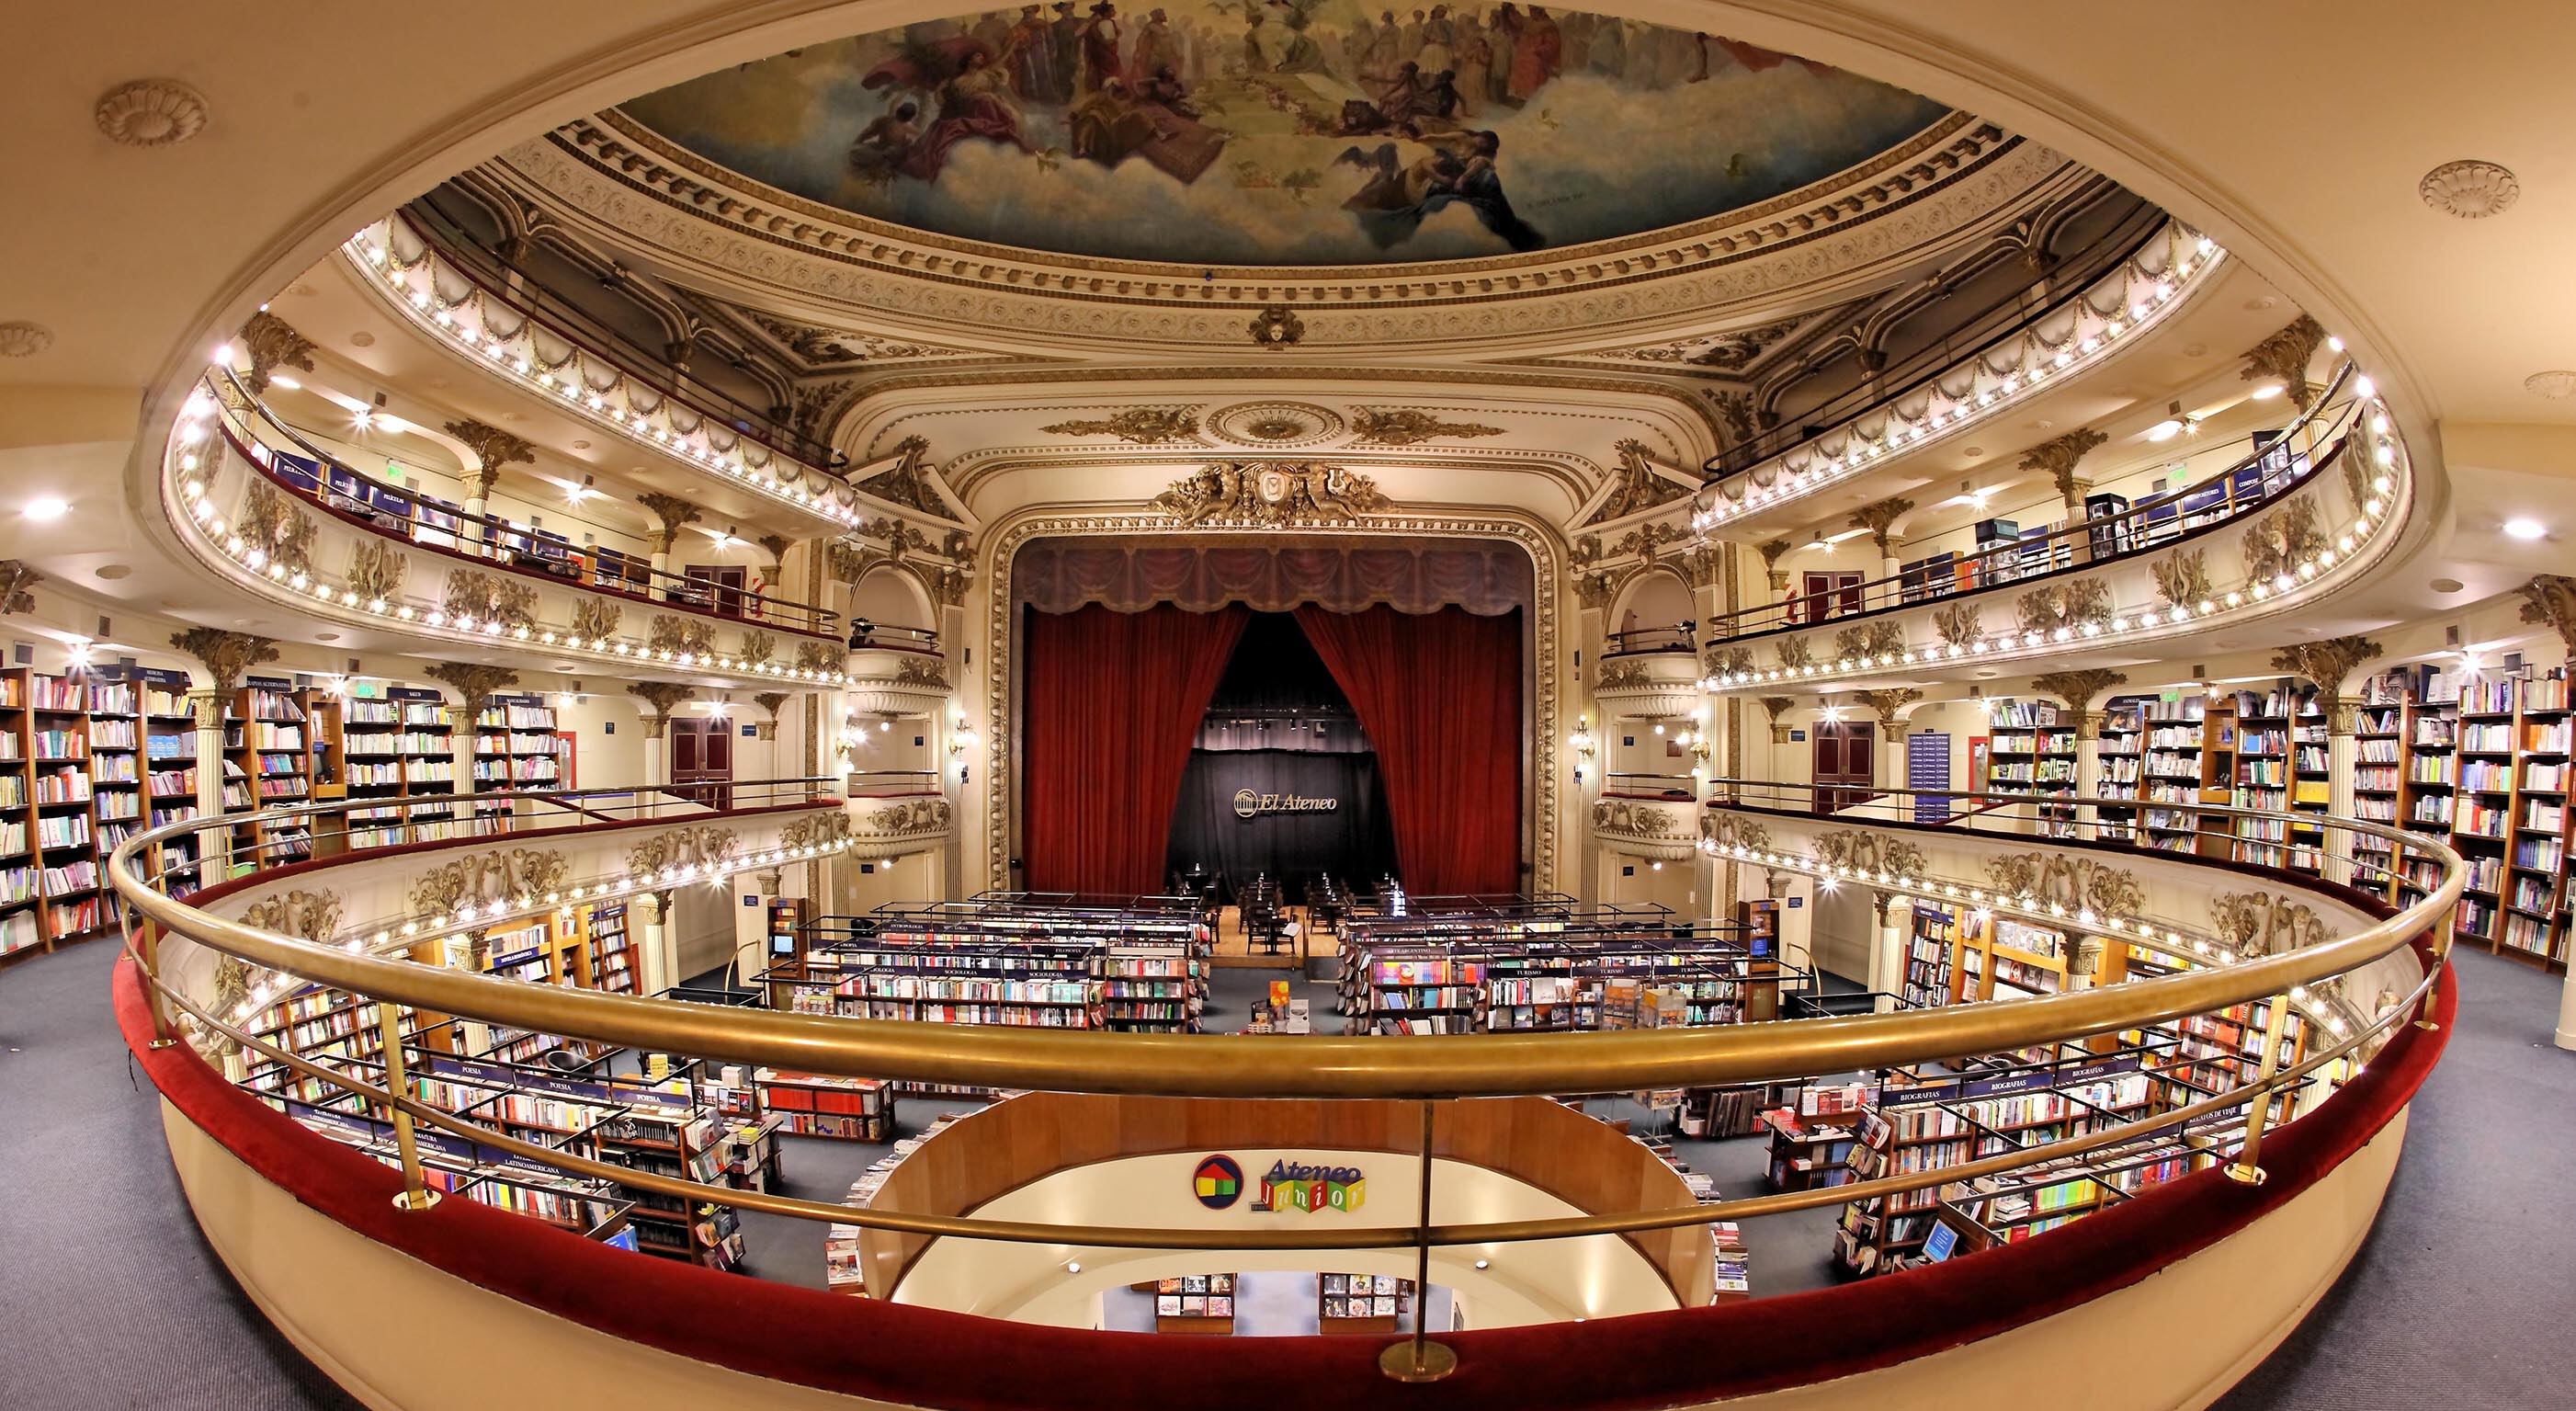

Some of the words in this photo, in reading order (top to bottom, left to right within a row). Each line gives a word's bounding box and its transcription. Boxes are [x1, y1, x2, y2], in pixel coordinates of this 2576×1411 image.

[1258, 793, 1280, 811] El
[1280, 793, 1338, 811] Ateneo
[462, 1065, 482, 1075] POESIA
[550, 1080, 573, 1091] POESIA
[636, 1094, 662, 1103] POESIA
[1900, 1090, 1941, 1101] BIOGRAFIAS
[505, 1158, 560, 1175] LATINOAMERICANA
[1266, 1158, 1362, 1181] Ateneo
